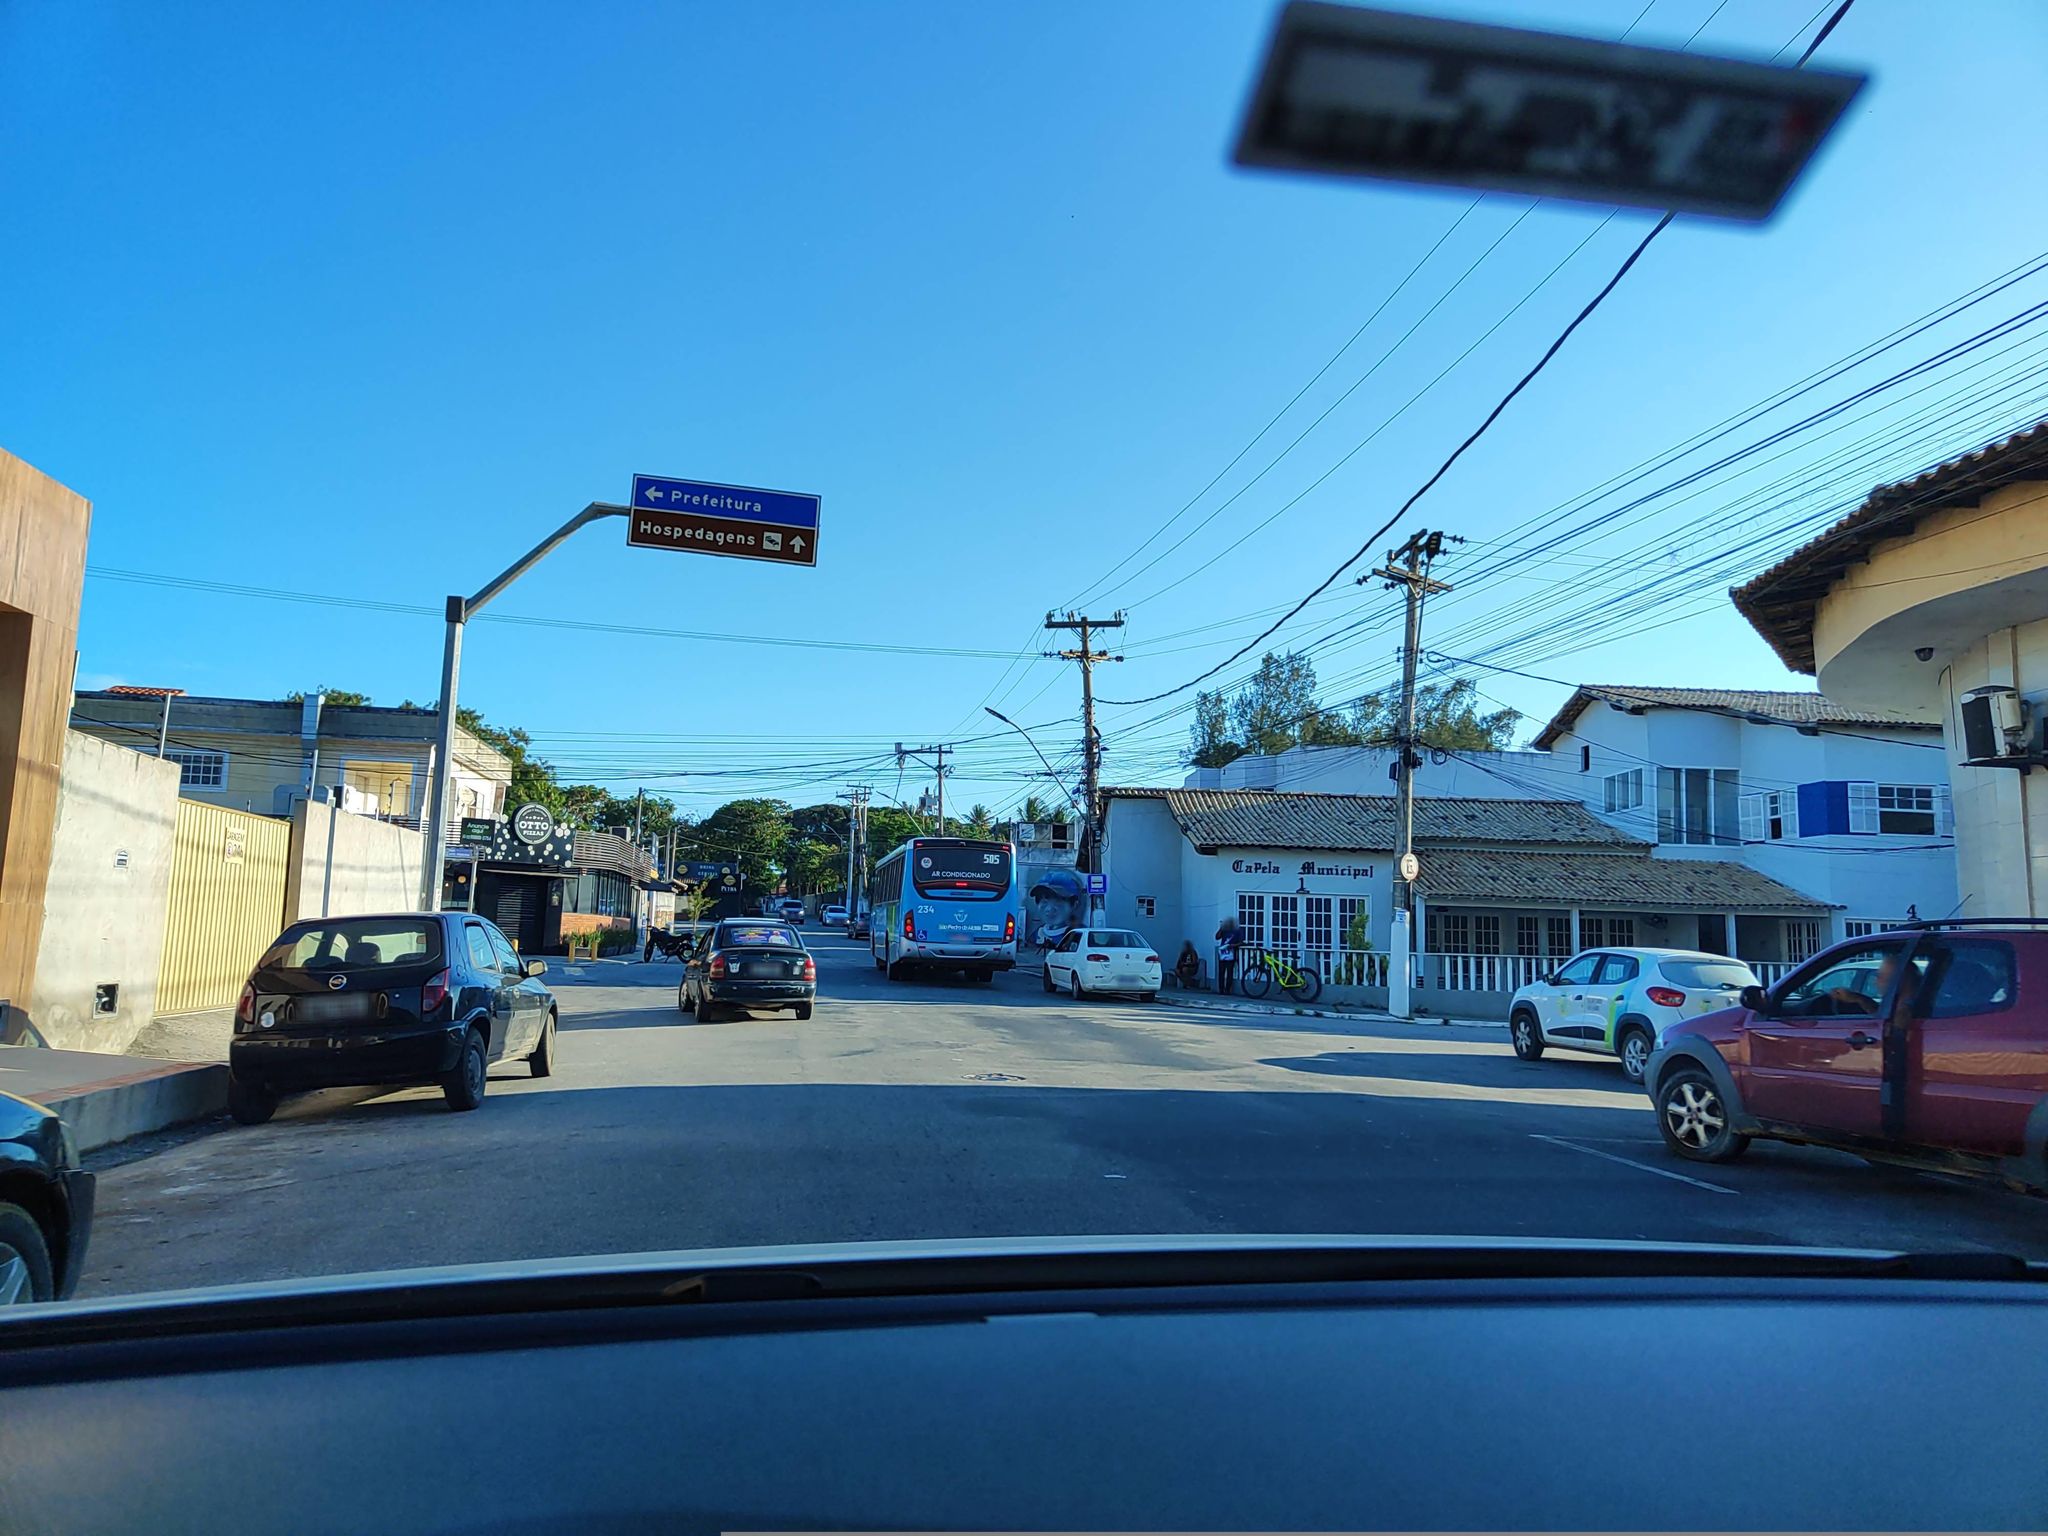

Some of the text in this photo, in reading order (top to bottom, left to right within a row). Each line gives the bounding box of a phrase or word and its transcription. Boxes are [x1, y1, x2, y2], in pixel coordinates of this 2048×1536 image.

[671, 490, 762, 513] Prefeitura
[639, 520, 756, 546] Hospedagens
[519, 820, 549, 831] OTTO
[983, 853, 1000, 865] 505
[941, 871, 991, 879] CONDICIONADO
[1297, 861, 1374, 879] Municipal
[917, 905, 935, 914] 234
[1906, 903, 1917, 919] 4
